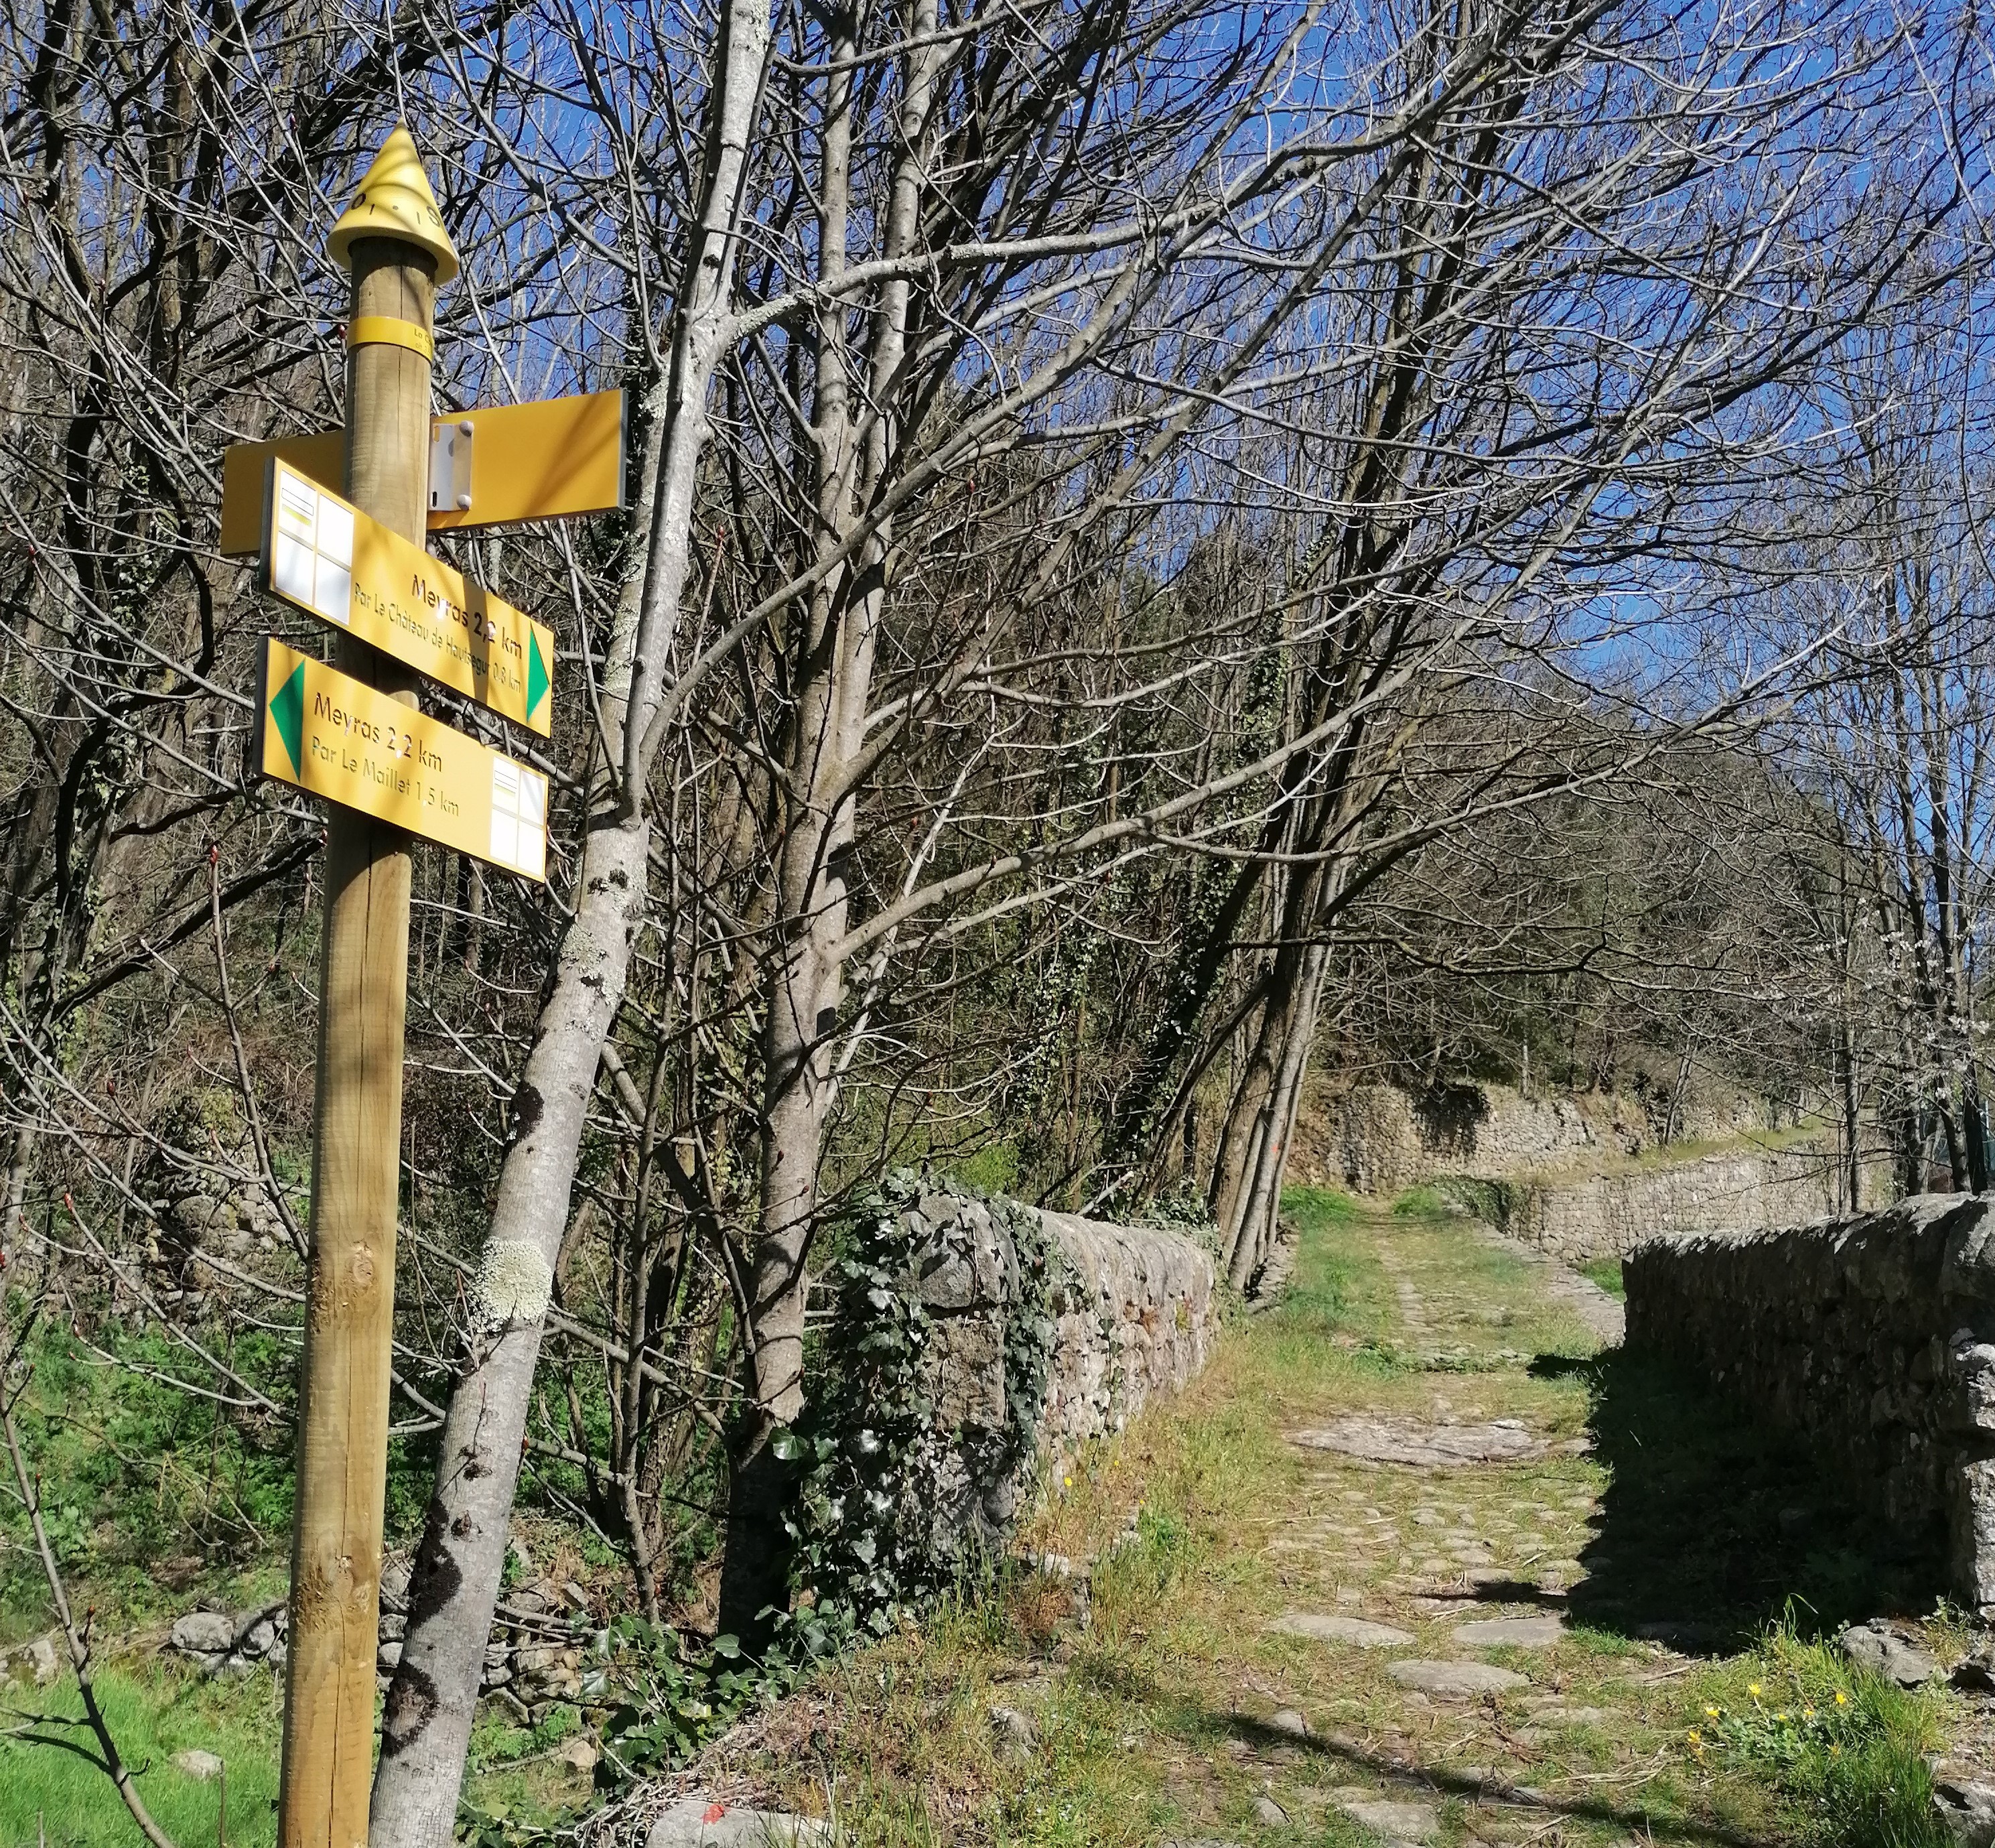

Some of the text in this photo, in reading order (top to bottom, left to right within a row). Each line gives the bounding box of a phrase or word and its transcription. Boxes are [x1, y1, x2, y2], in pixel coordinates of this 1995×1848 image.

[354, 582, 371, 609] Par
[374, 593, 385, 617] Le
[389, 602, 429, 641] Château
[431, 627, 443, 650] de
[509, 669, 521, 694] km
[411, 574, 522, 660] Meyras 2,2 km
[314, 692, 442, 773] Meyras 2,2 km
[312, 735, 336, 764] Par
[342, 748, 357, 773] Le
[363, 758, 410, 796] Maillet
[440, 791, 459, 817] km
